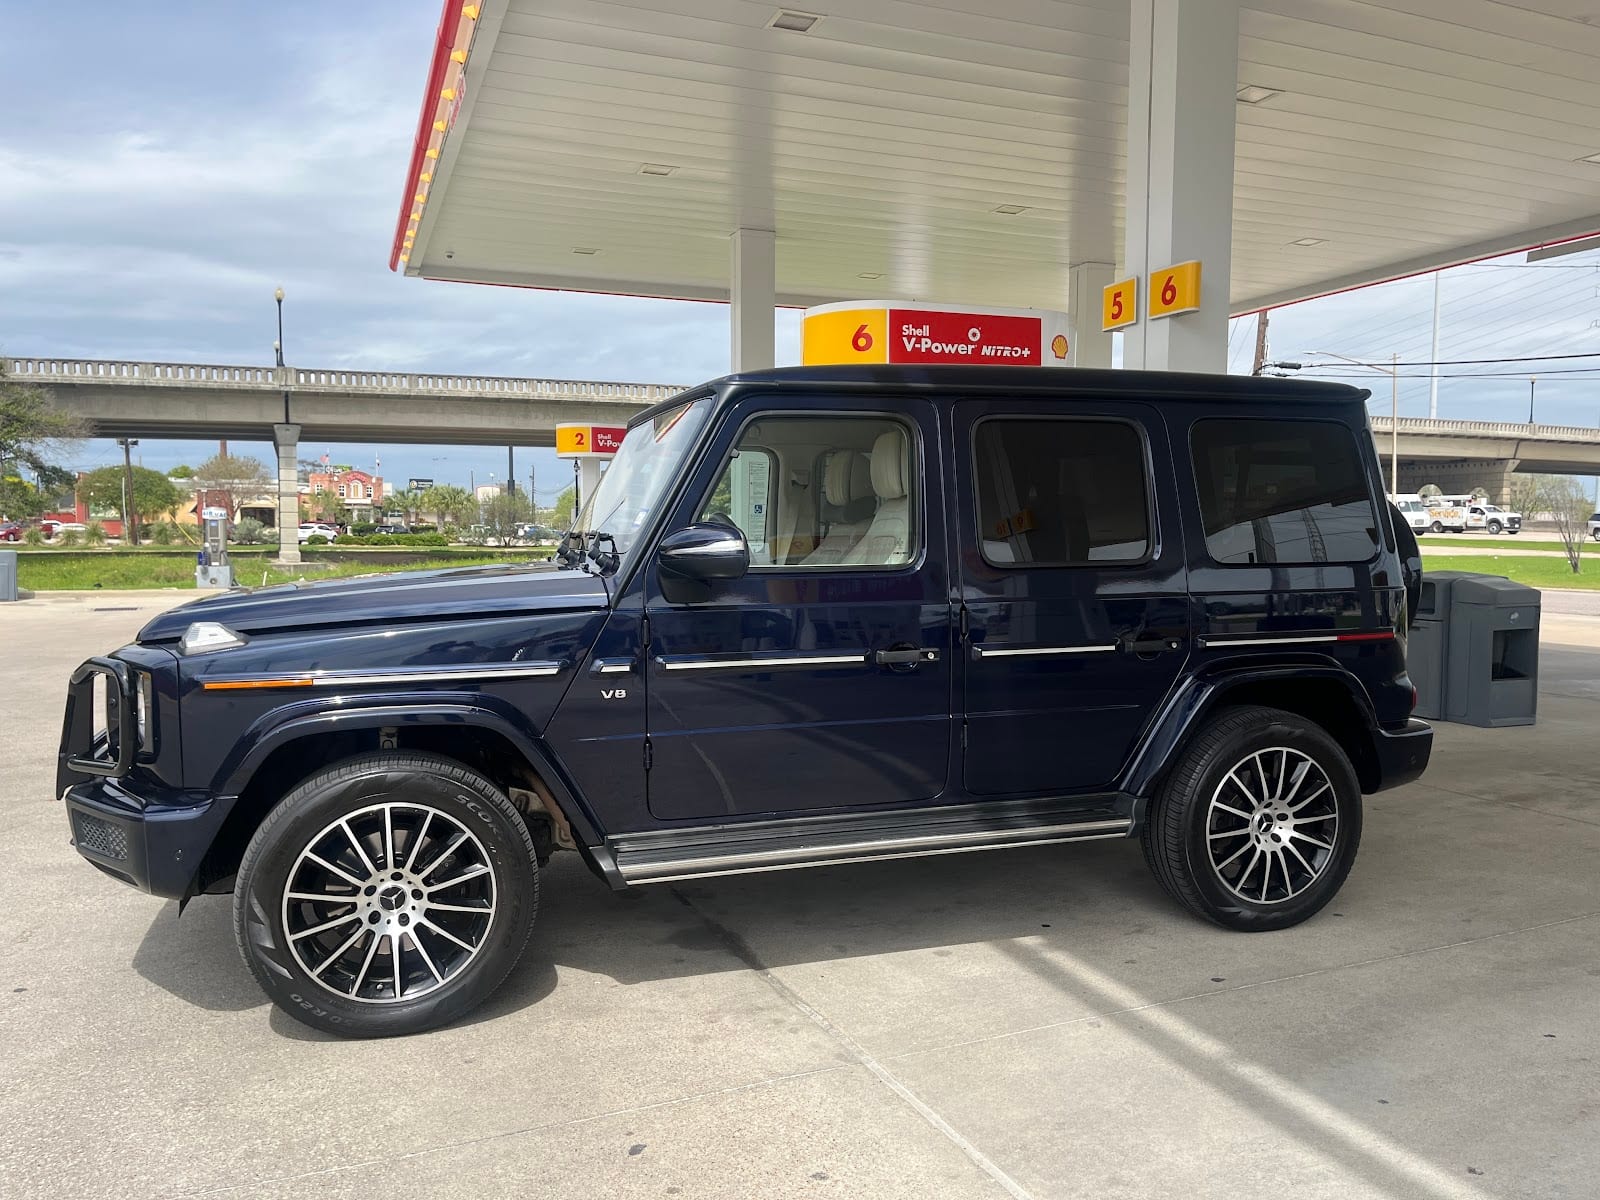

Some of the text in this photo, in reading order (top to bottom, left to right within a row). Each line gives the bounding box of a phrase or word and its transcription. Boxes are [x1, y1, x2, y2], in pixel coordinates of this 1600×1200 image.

[1160, 275, 1178, 306] 6
[1110, 291, 1124, 321] 5
[851, 324, 874, 352] 6
[902, 324, 930, 337] Shell
[902, 337, 975, 355] V-Power
[575, 432, 585, 446] 2
[600, 689, 627, 699] V8
